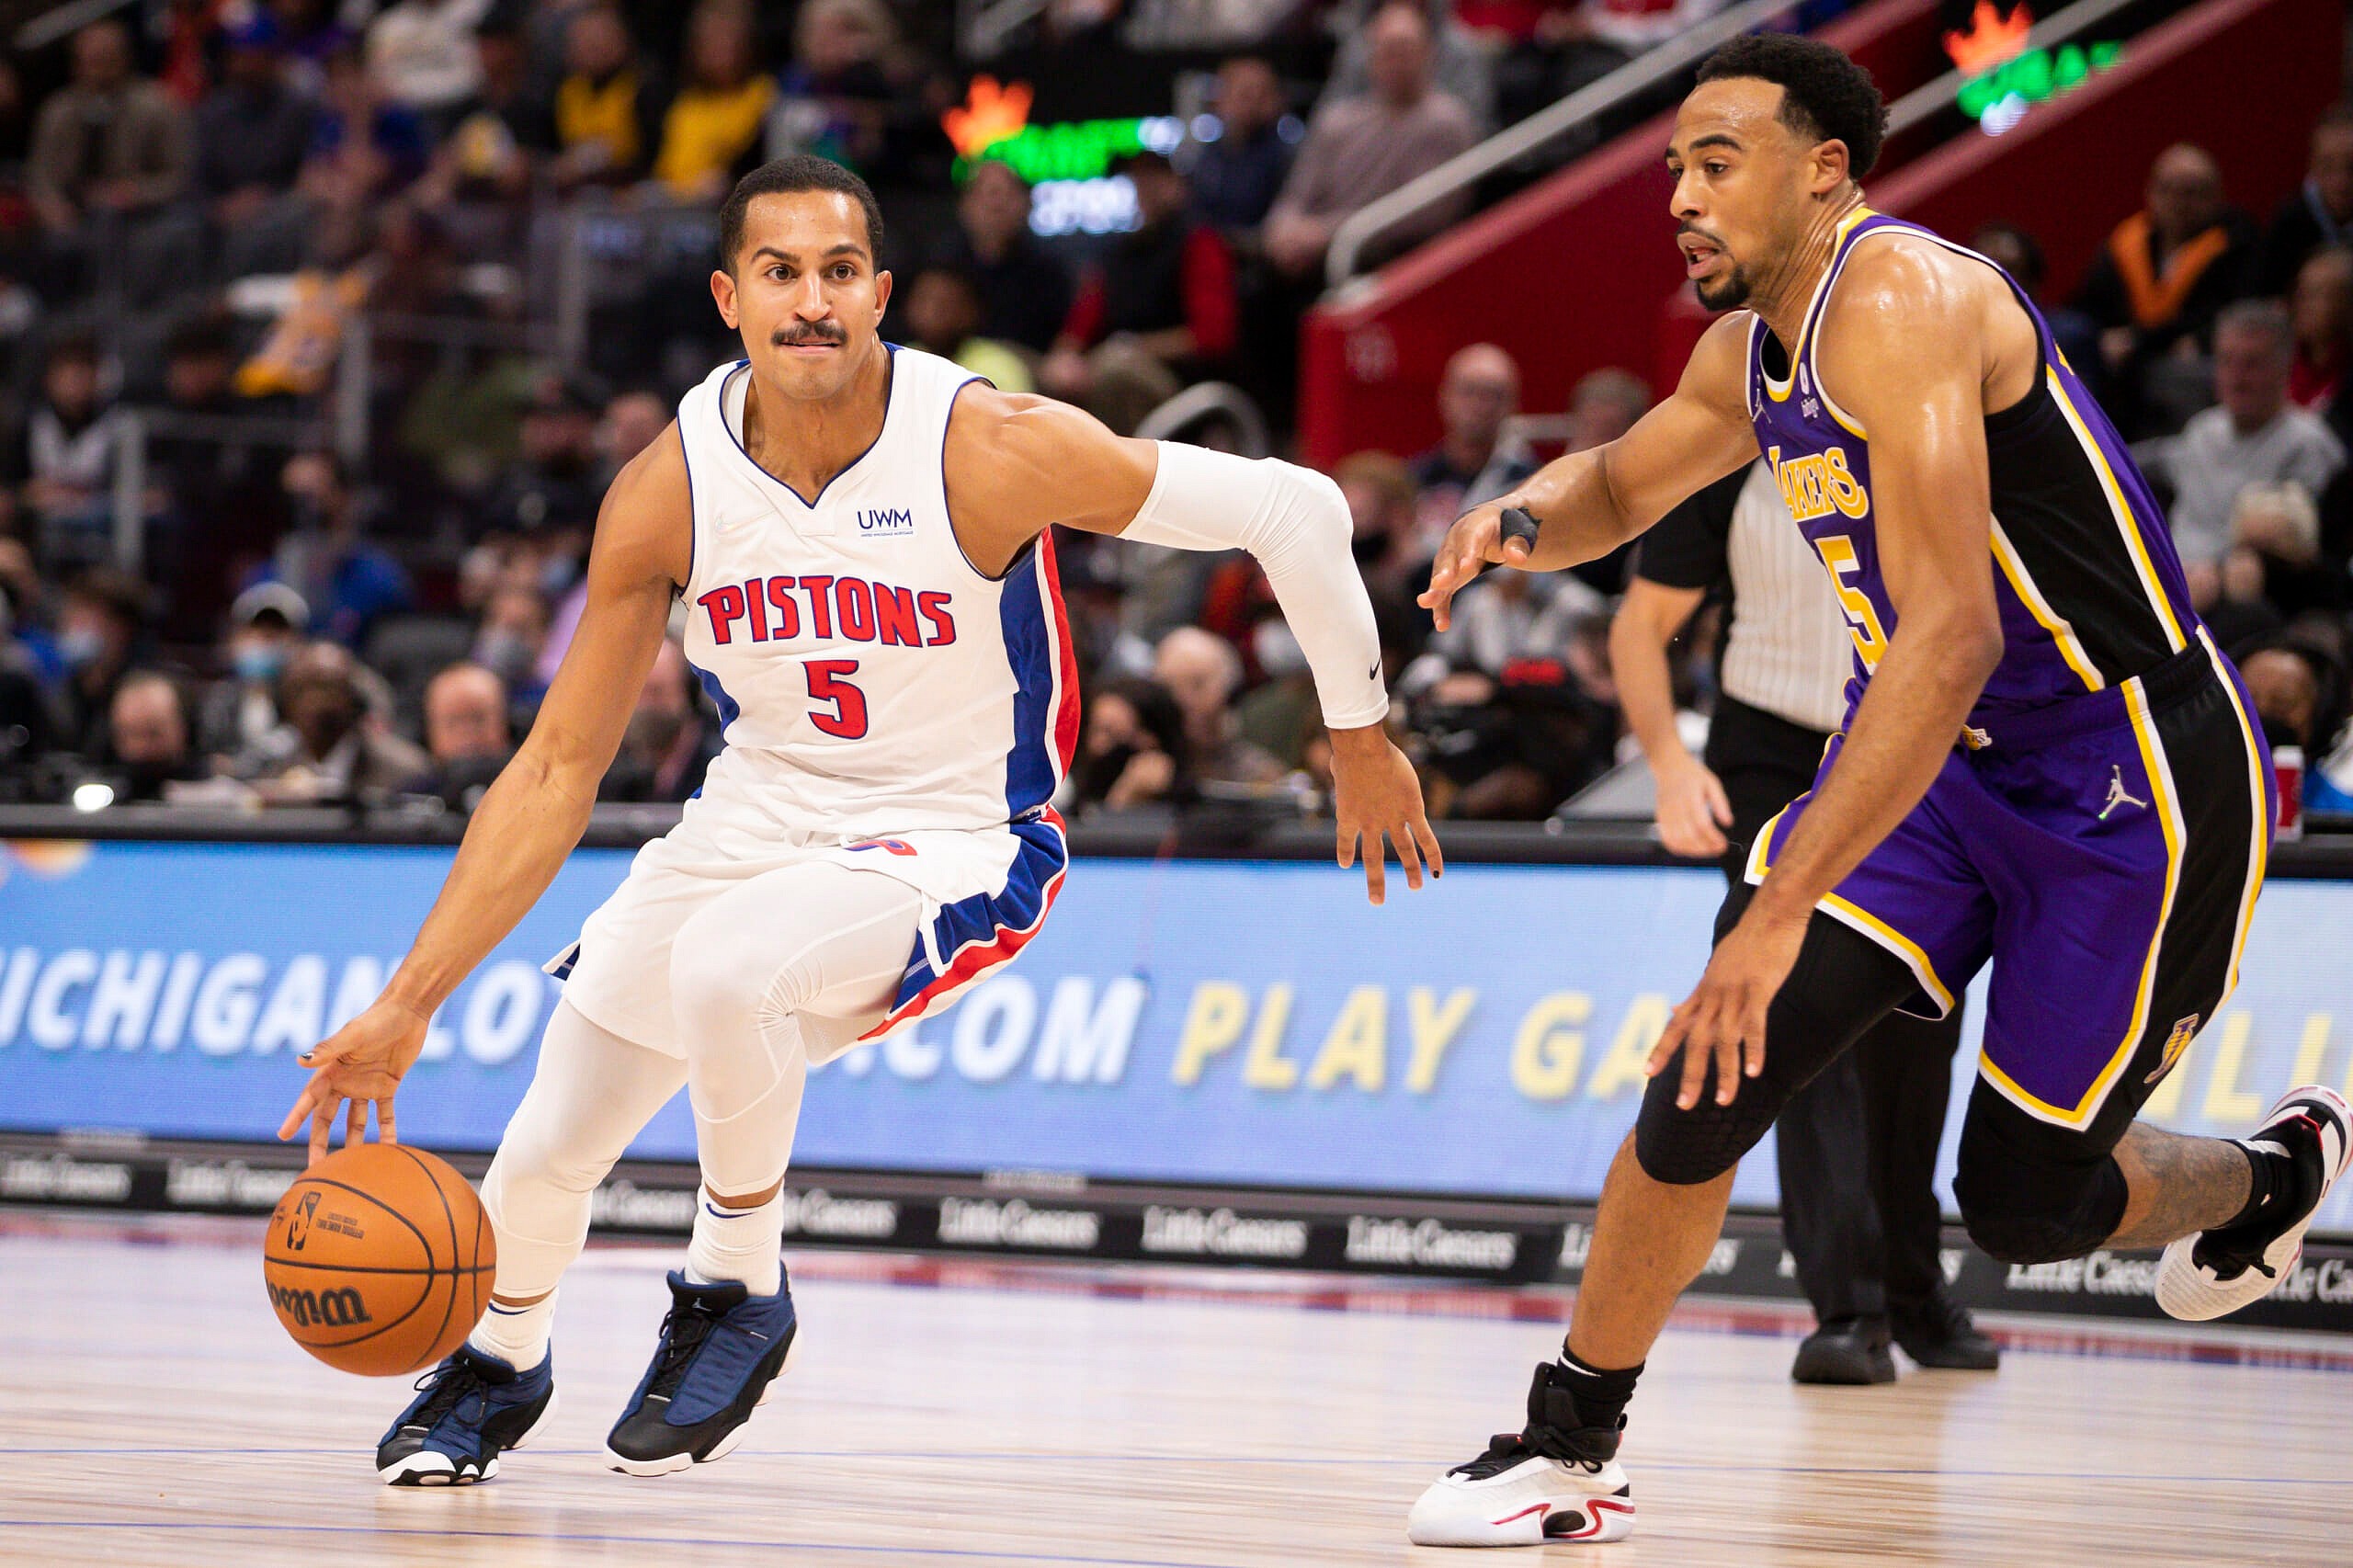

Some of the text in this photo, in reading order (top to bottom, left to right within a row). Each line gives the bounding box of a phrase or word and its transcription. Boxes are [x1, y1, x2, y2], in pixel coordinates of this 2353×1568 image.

[858, 508, 913, 529] UWM
[697, 575, 957, 648] PISTONS
[801, 659, 868, 740] 5
[1172, 980, 1477, 1095] PLAY
[1510, 990, 1671, 1100] GA
[267, 1278, 372, 1328] Wilso
